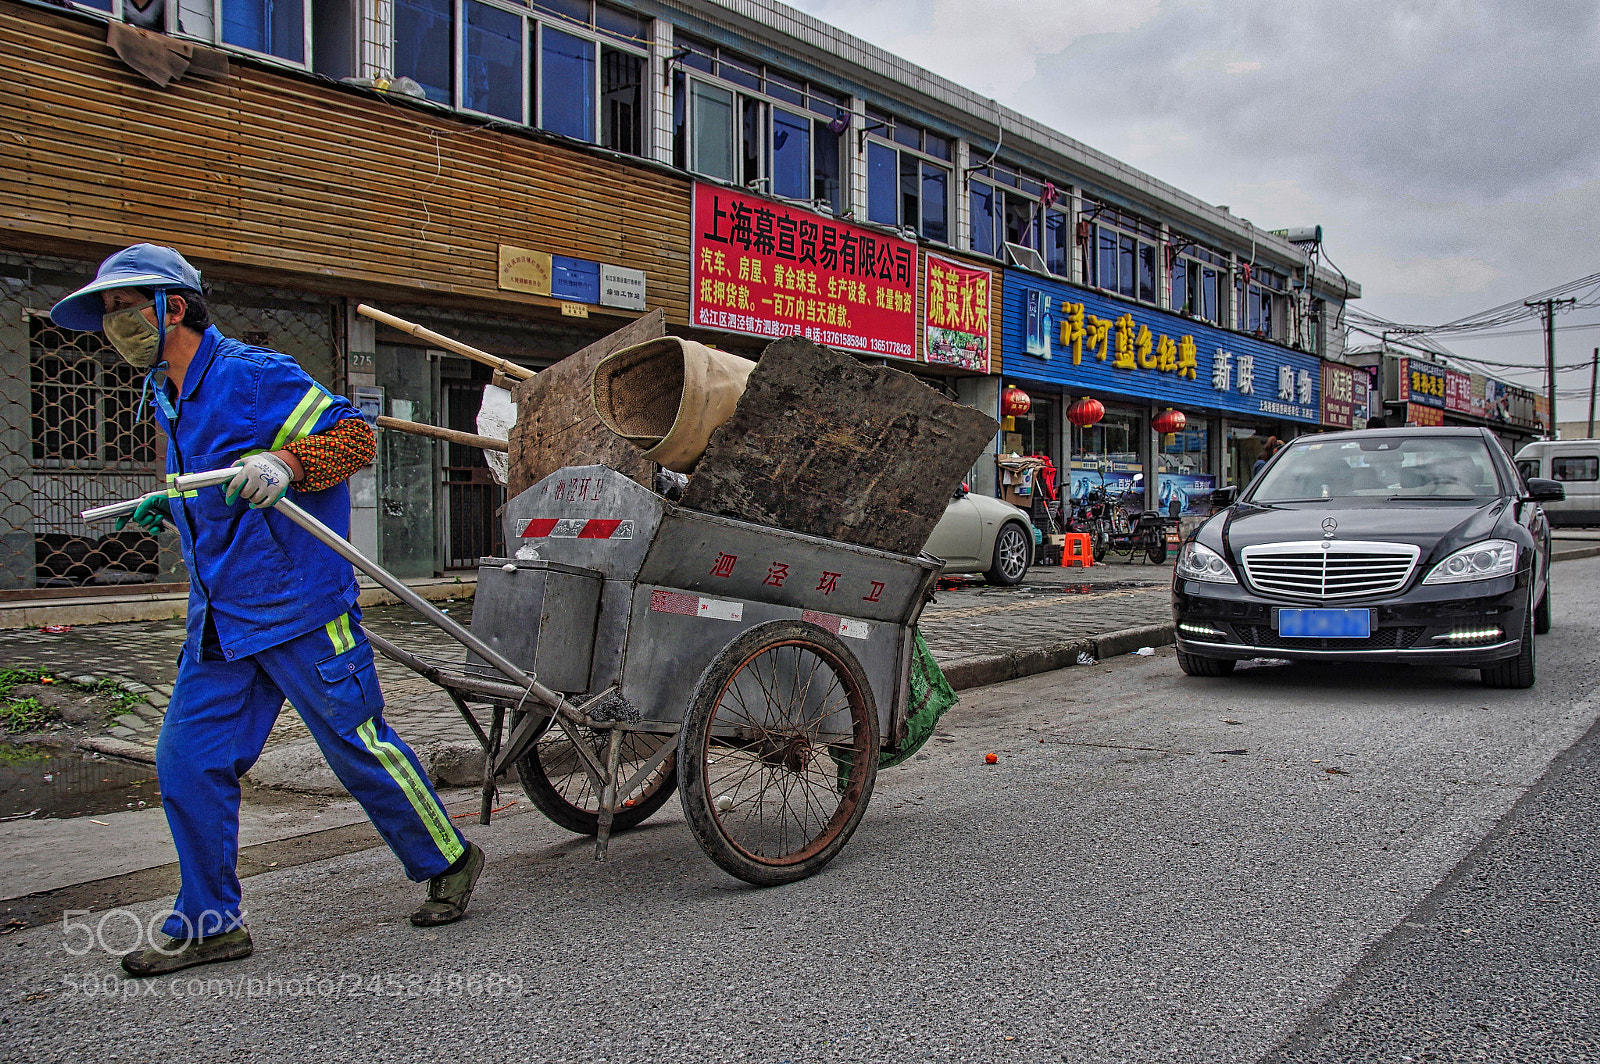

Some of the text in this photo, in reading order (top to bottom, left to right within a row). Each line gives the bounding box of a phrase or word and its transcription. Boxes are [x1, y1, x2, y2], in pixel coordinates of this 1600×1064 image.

[703, 195, 911, 288] 上海幕宣贸易有限公司
[929, 265, 988, 334] 蔬菜水果
[352, 355, 372, 366] 275
[870, 337, 912, 356] 13651778428
[1060, 301, 1198, 380] 洋河蓝色经典
[710, 551, 886, 603] 泗泾环卫
